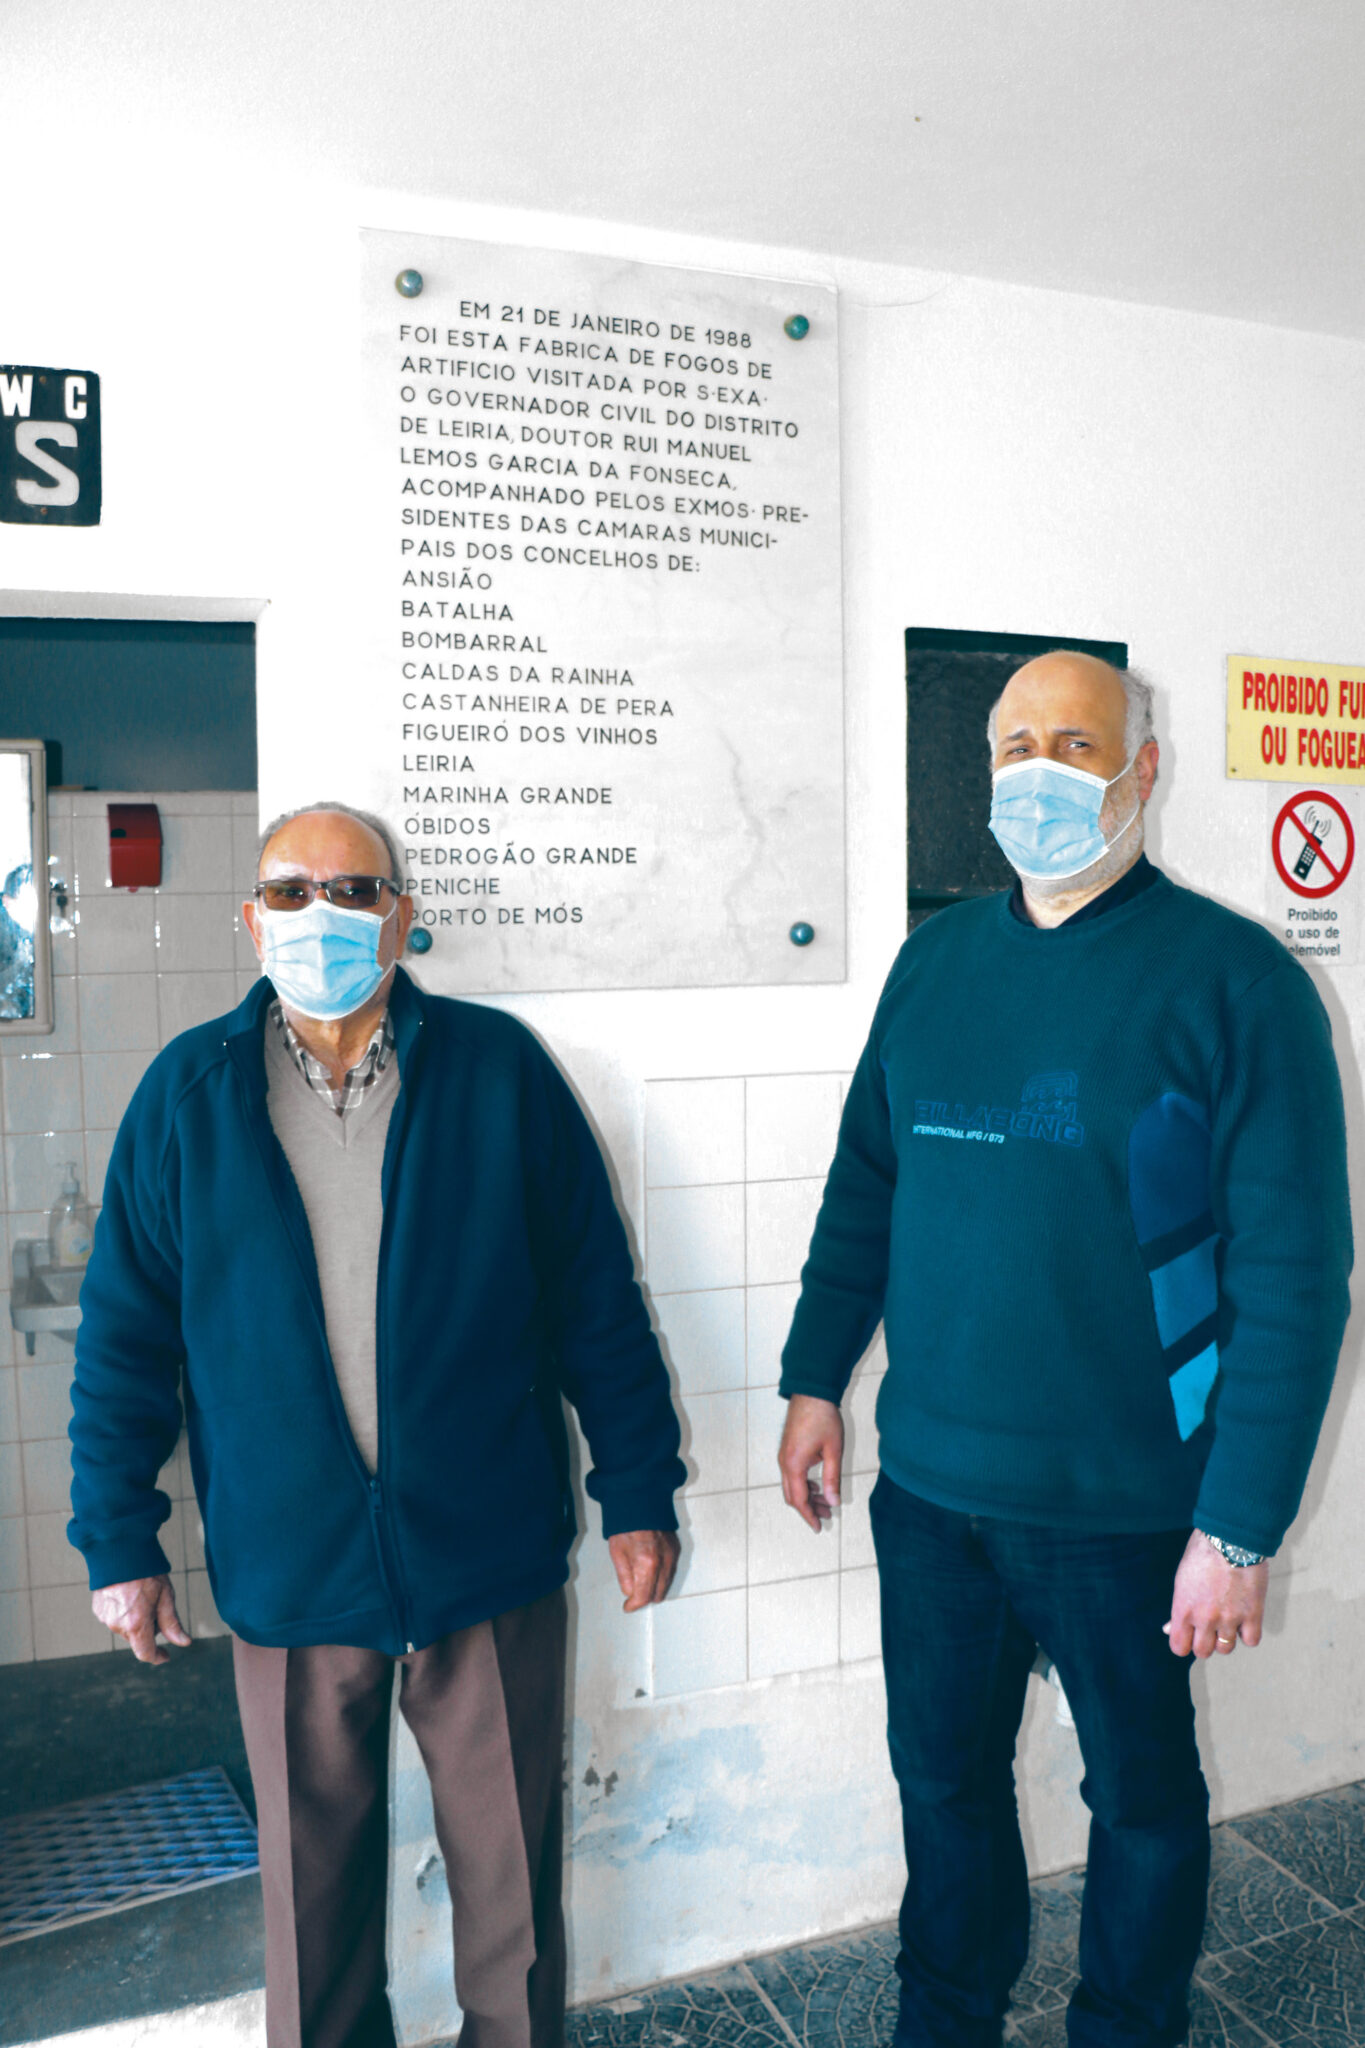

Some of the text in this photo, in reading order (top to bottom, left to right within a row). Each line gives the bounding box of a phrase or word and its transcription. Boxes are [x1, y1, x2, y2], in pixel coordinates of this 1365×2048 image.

[460, 301, 751, 348] EM 21 DE JANEIRO DE 1988
[400, 325, 771, 379] FOI ESTA FABRICA DE FOGOS DE
[401, 356, 515, 381] ARTIFICIO
[527, 367, 632, 393] VISITADA
[644, 379, 686, 398] POR
[401, 386, 798, 438] O GOVERNADOR CIVIL DO DISTRITO
[401, 416, 751, 462] DE LEIRIA, DOUTOR RUI MANUEL
[15, 421, 80, 506] S
[401, 447, 736, 490] LEMOS GARCIA DA FONSECA,
[402, 478, 585, 506] ACOMPANHADO
[596, 491, 664, 511] PELOS
[763, 505, 808, 523] PRE-
[402, 508, 777, 548] SIDENTES DAS CAMARAS MUNICI-
[402, 539, 699, 572] PAIS DOS CONCELHOS DE:
[403, 567, 492, 590] ANSIÃO
[402, 600, 513, 621] BATALHA
[402, 631, 547, 653] BOMBARRAL
[402, 662, 634, 686] CALDAS DA RAINHA
[403, 693, 673, 716] CASTANHEIRA DE PERA
[1242, 671, 1365, 720] PROIBIDO FU
[403, 720, 657, 745] FIGUEIRÓ DOS VINHOS
[1261, 725, 1287, 766] OU
[404, 755, 474, 772] LEIRIA
[404, 787, 612, 804] MARINHA GRANDE
[405, 813, 490, 835] ÓBIDOS
[405, 842, 637, 865] PEDROGÃO GRANDE
[406, 878, 500, 895] PENICHE
[498, 908, 524, 924] DE
[535, 903, 583, 924] MÓS
[1288, 908, 1338, 921] Proibido
[1285, 926, 1340, 939] o uso de
[1288, 944, 1340, 957] elemóvel
